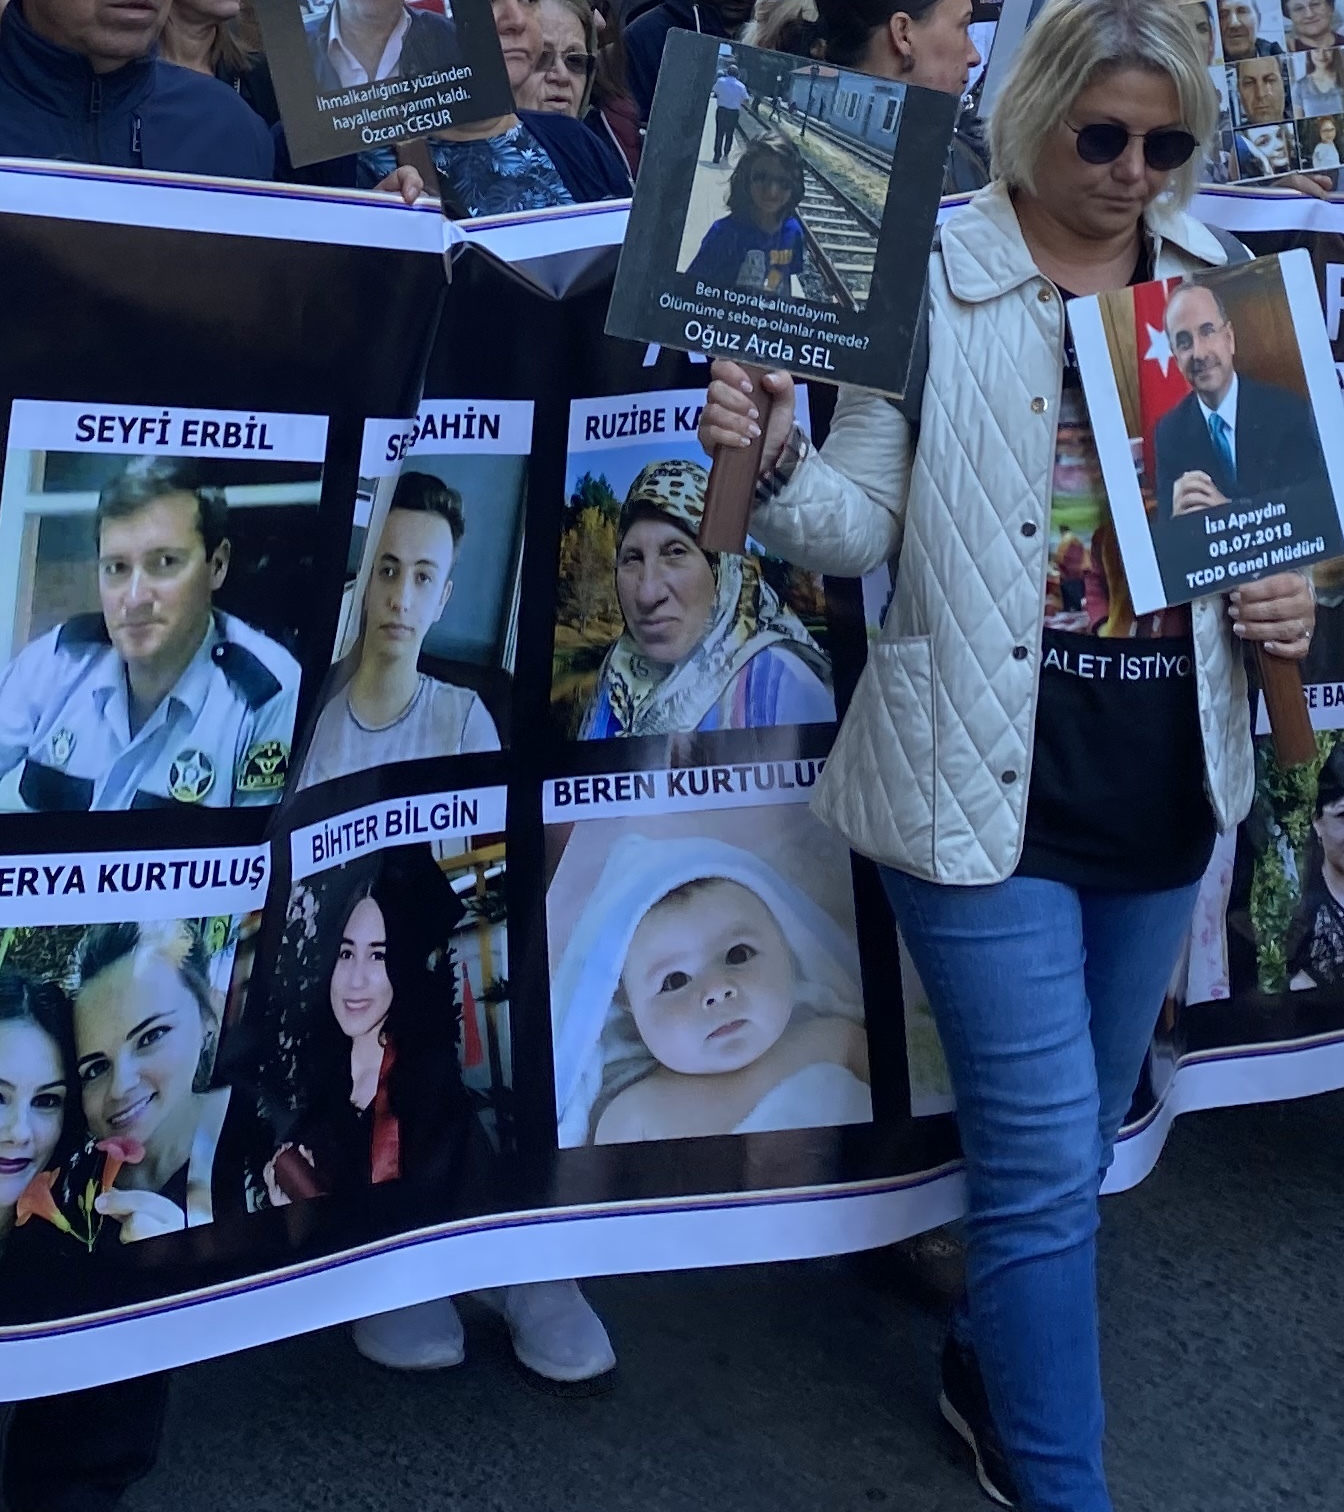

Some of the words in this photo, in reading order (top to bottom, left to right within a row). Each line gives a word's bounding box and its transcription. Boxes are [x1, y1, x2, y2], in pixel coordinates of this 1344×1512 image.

[411, 66, 474, 93] yüzünden
[333, 103, 399, 131] hayallerim
[400, 96, 437, 119] yarım
[437, 86, 472, 107] kaldı.
[361, 122, 406, 144] Özcan
[407, 110, 453, 134] CESUR
[659, 292, 732, 320] Ölümüme
[727, 309, 768, 330] sebep
[769, 314, 816, 338] olanlar
[817, 328, 870, 350] nerede?
[695, 281, 721, 300] Ben
[723, 289, 766, 312] toprak
[769, 294, 840, 325] altındayım.
[684, 319, 740, 350] Oğuz
[744, 333, 794, 362] Arda
[798, 347, 836, 371] SEL
[75, 410, 172, 447] SEYFİ
[180, 414, 275, 451] ERBİL
[585, 404, 666, 441] RUZİBE
[1204, 515, 1227, 536] İsa
[1228, 501, 1287, 531] Apaydın
[1209, 522, 1293, 558] 08.07.2018
[1186, 566, 1226, 590] TCDD
[1228, 555, 1268, 578] Genel
[1269, 536, 1326, 567] Müdürü
[554, 772, 656, 808] BEREN
[311, 811, 380, 865] BİHTER
[384, 797, 480, 840] BİLGİN
[96, 855, 267, 895] KURTULUŞ
